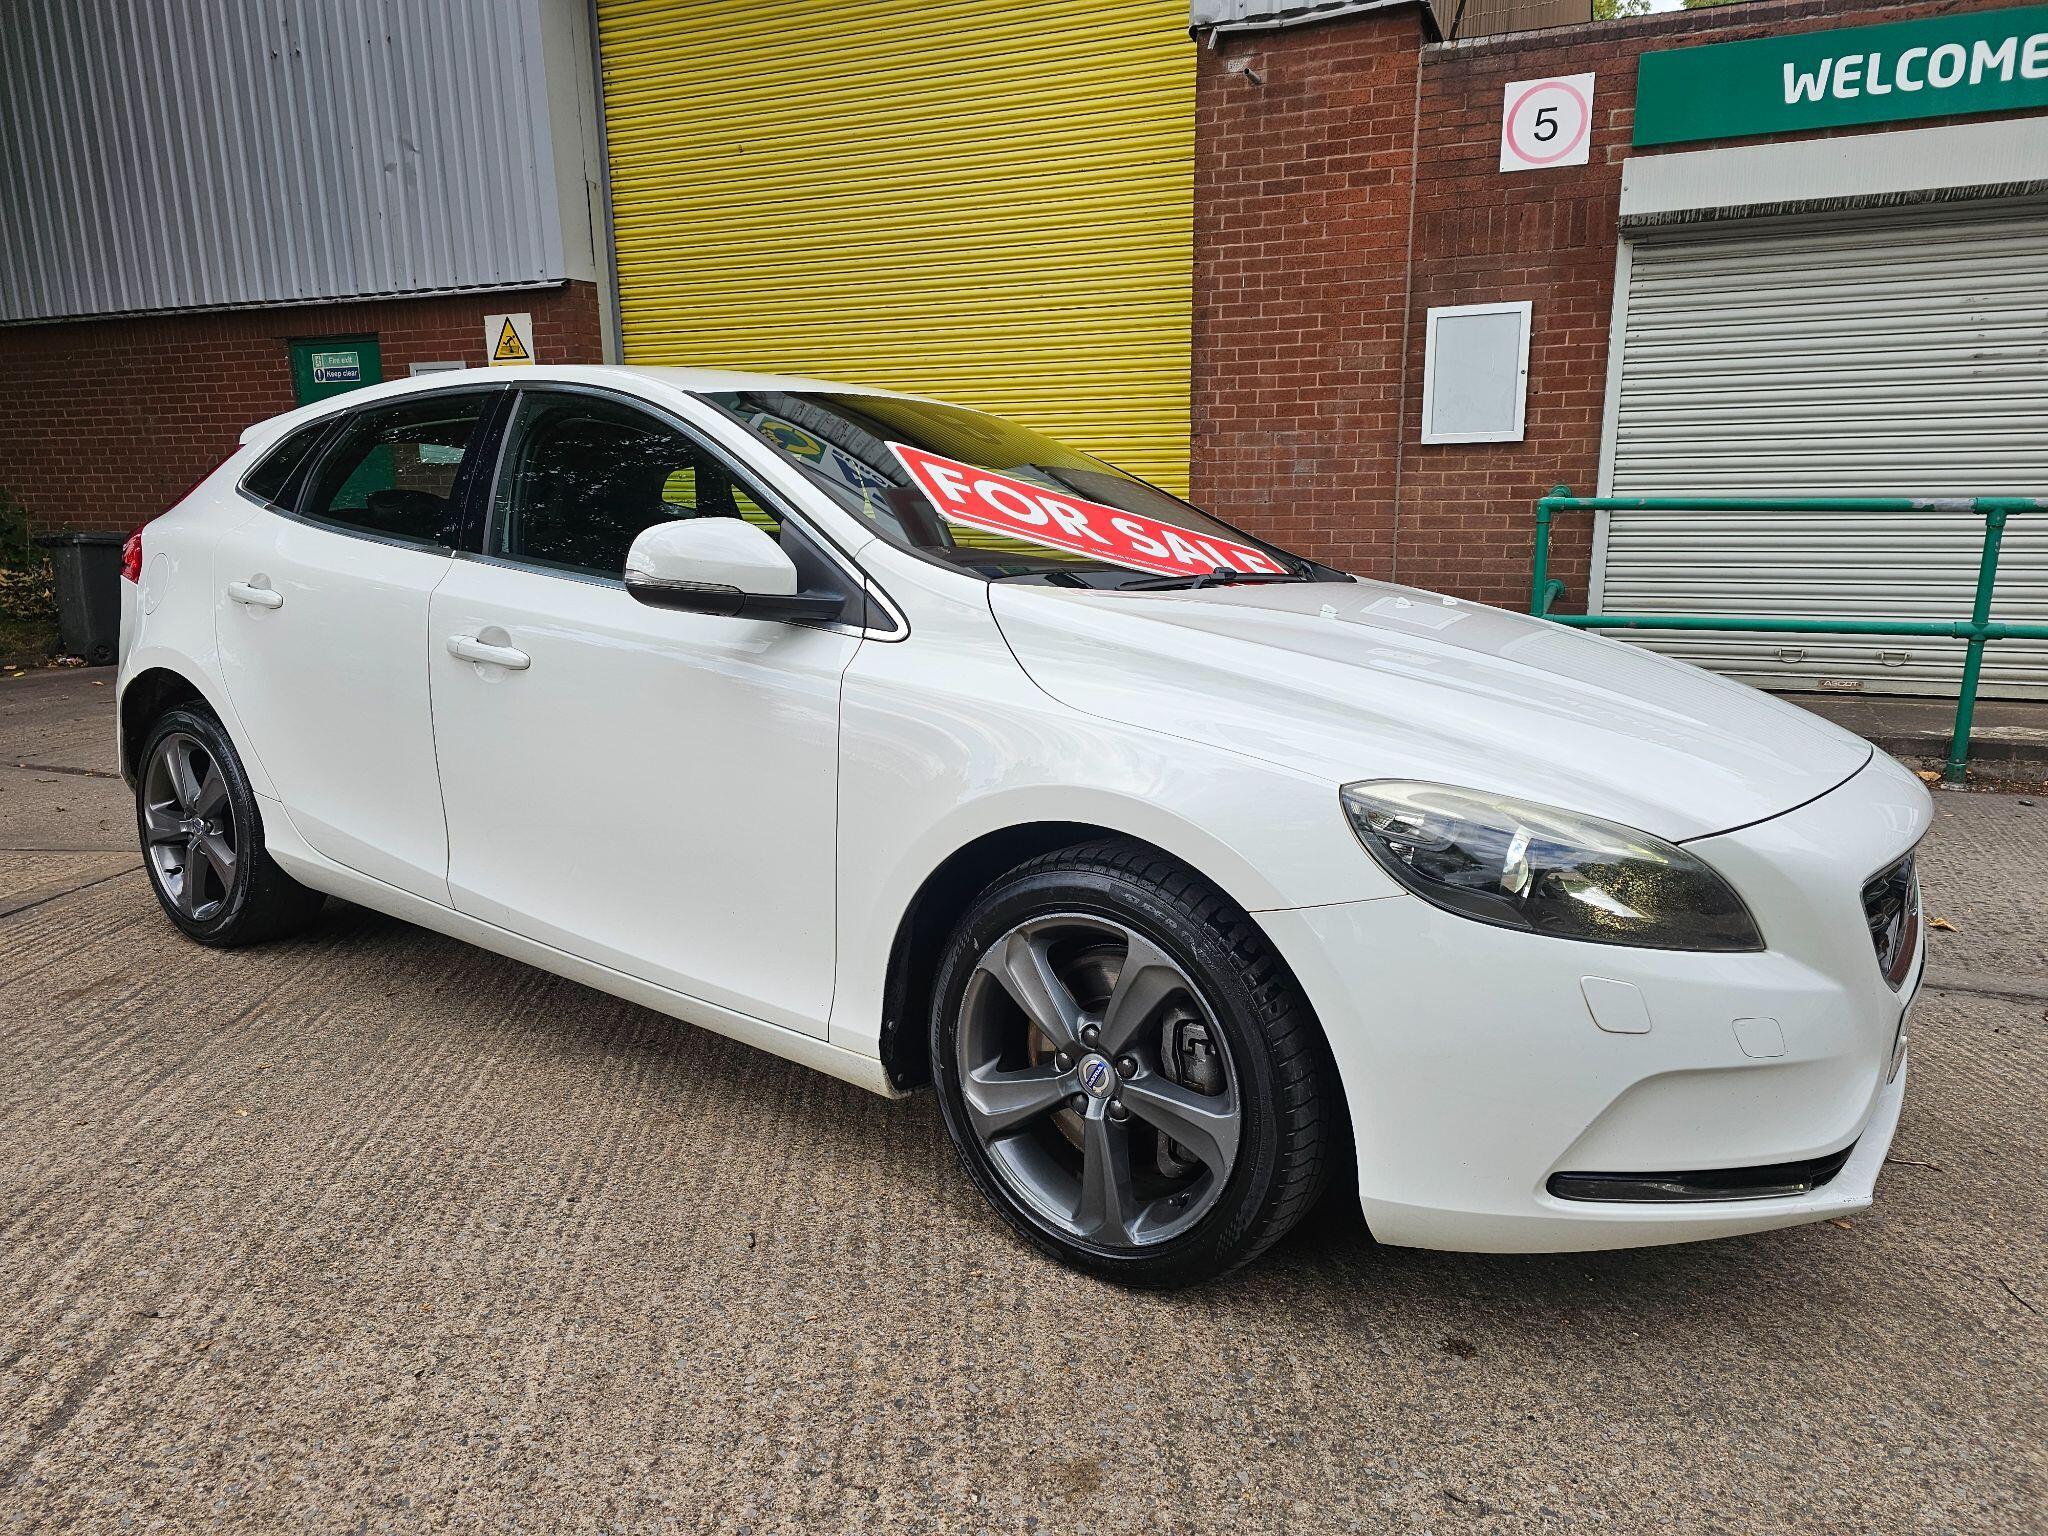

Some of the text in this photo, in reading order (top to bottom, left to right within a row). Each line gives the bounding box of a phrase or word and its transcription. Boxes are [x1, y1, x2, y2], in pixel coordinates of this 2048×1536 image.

[1783, 32, 2048, 104] WELCOME
[1533, 106, 1559, 142] 5
[328, 355, 353, 364] Fire exit
[326, 369, 357, 379] Keep clear
[921, 460, 1113, 545] FOR
[1111, 517, 1276, 574] SALE
[1824, 680, 1859, 688] ASCOT
